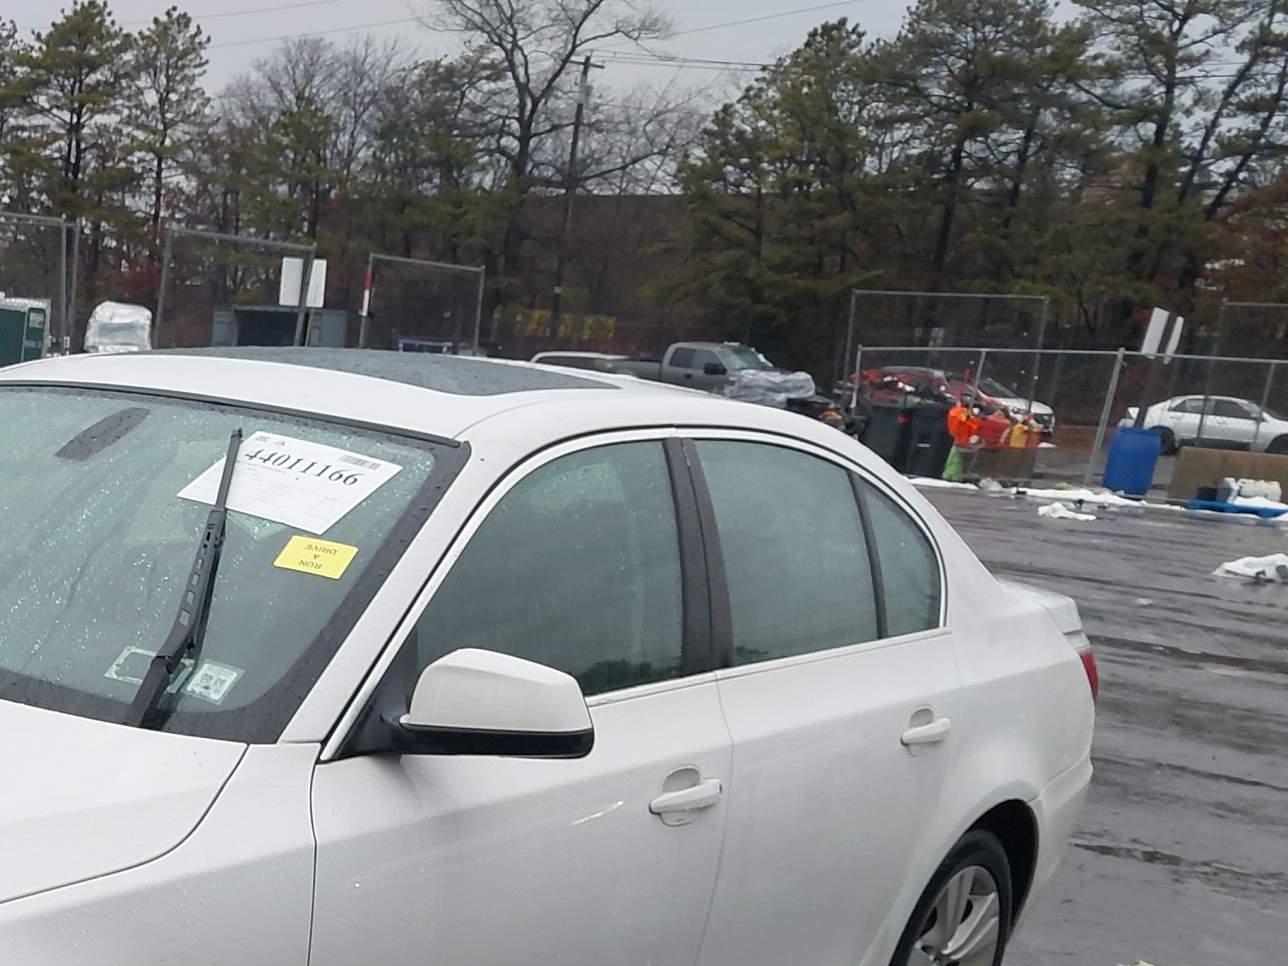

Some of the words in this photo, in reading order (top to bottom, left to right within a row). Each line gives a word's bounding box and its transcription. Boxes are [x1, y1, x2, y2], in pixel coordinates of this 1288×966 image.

[244, 449, 365, 486] 44011166
[305, 544, 337, 556] DRIVE
[298, 559, 322, 570] RUN
